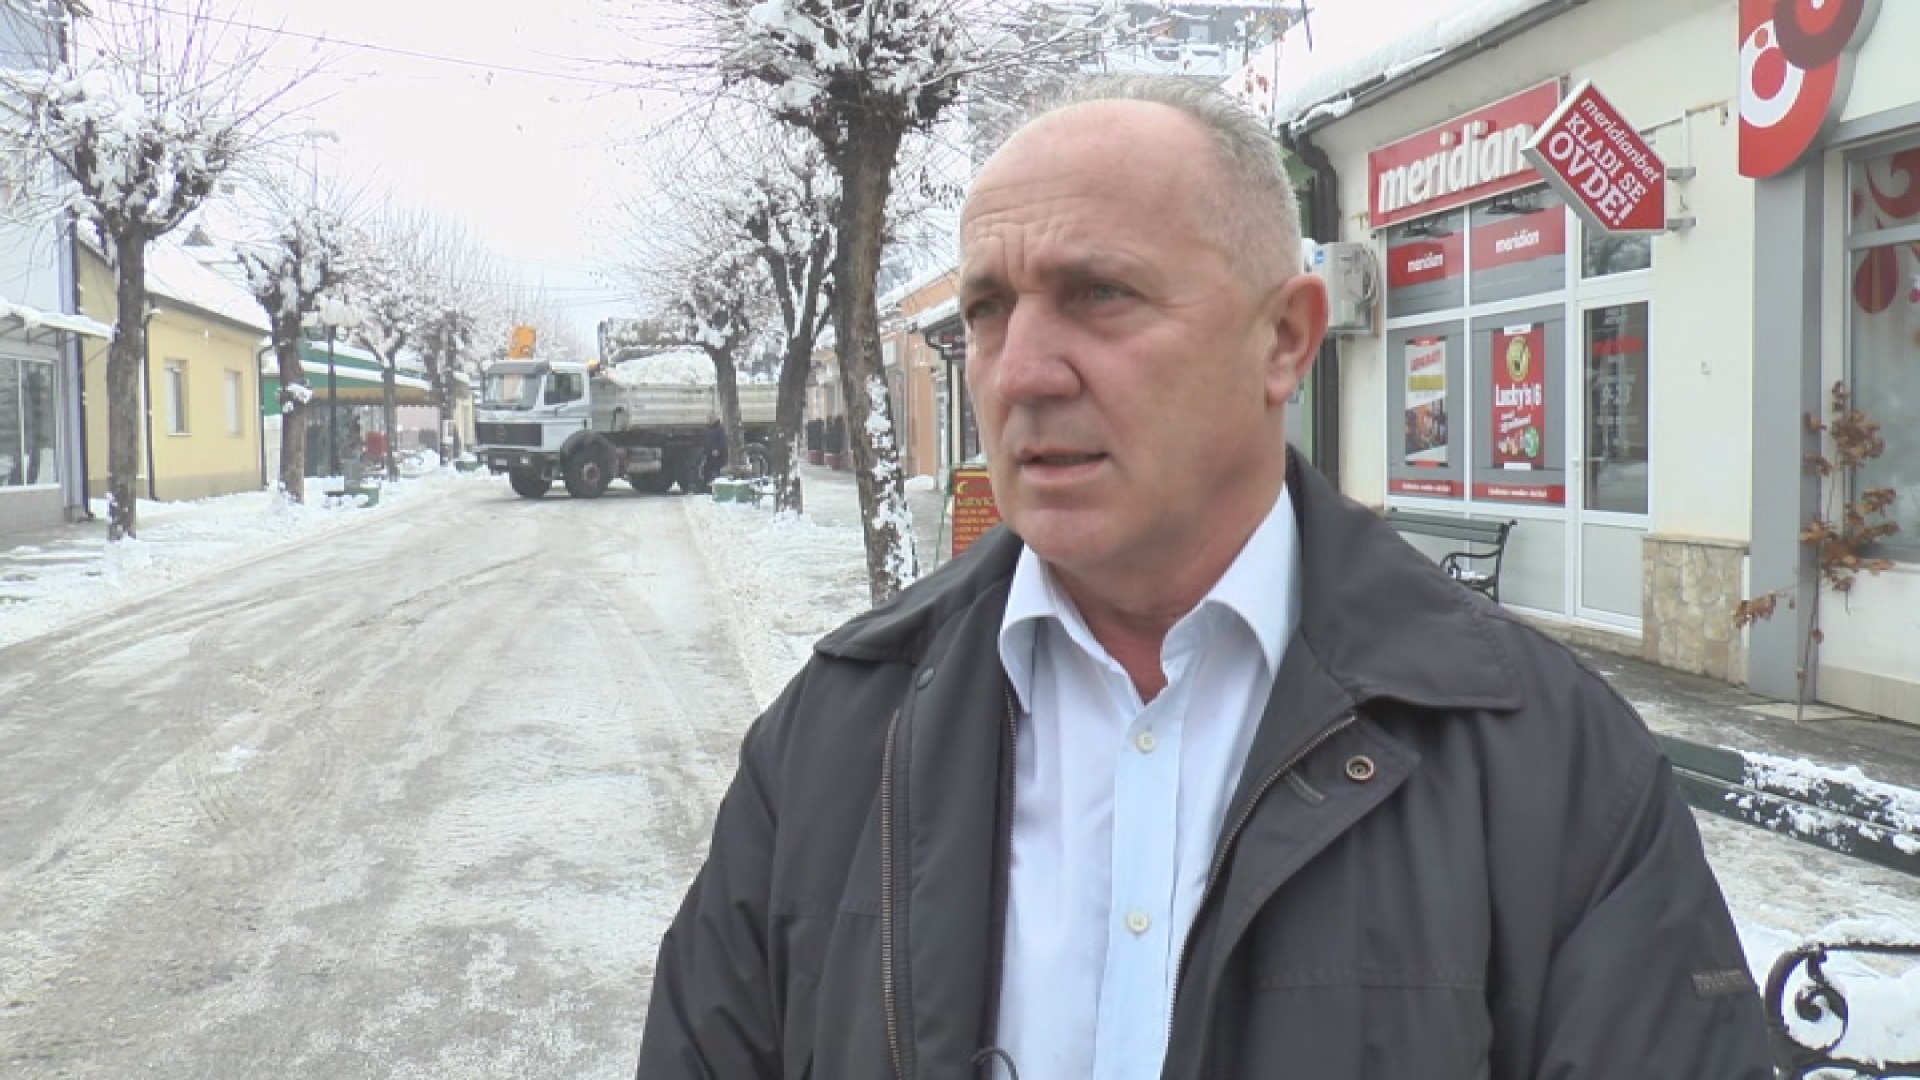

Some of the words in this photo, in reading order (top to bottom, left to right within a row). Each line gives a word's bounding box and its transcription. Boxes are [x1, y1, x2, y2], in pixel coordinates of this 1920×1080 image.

[1378, 119, 1536, 214] meridian
[1549, 131, 1633, 226] OVDE!
[1565, 111, 1624, 178] KLADI
[1619, 172, 1647, 203] SE
[1580, 98, 1661, 184] meridianbet
[1407, 251, 1444, 273] meridian
[1495, 228, 1540, 253] meridian
